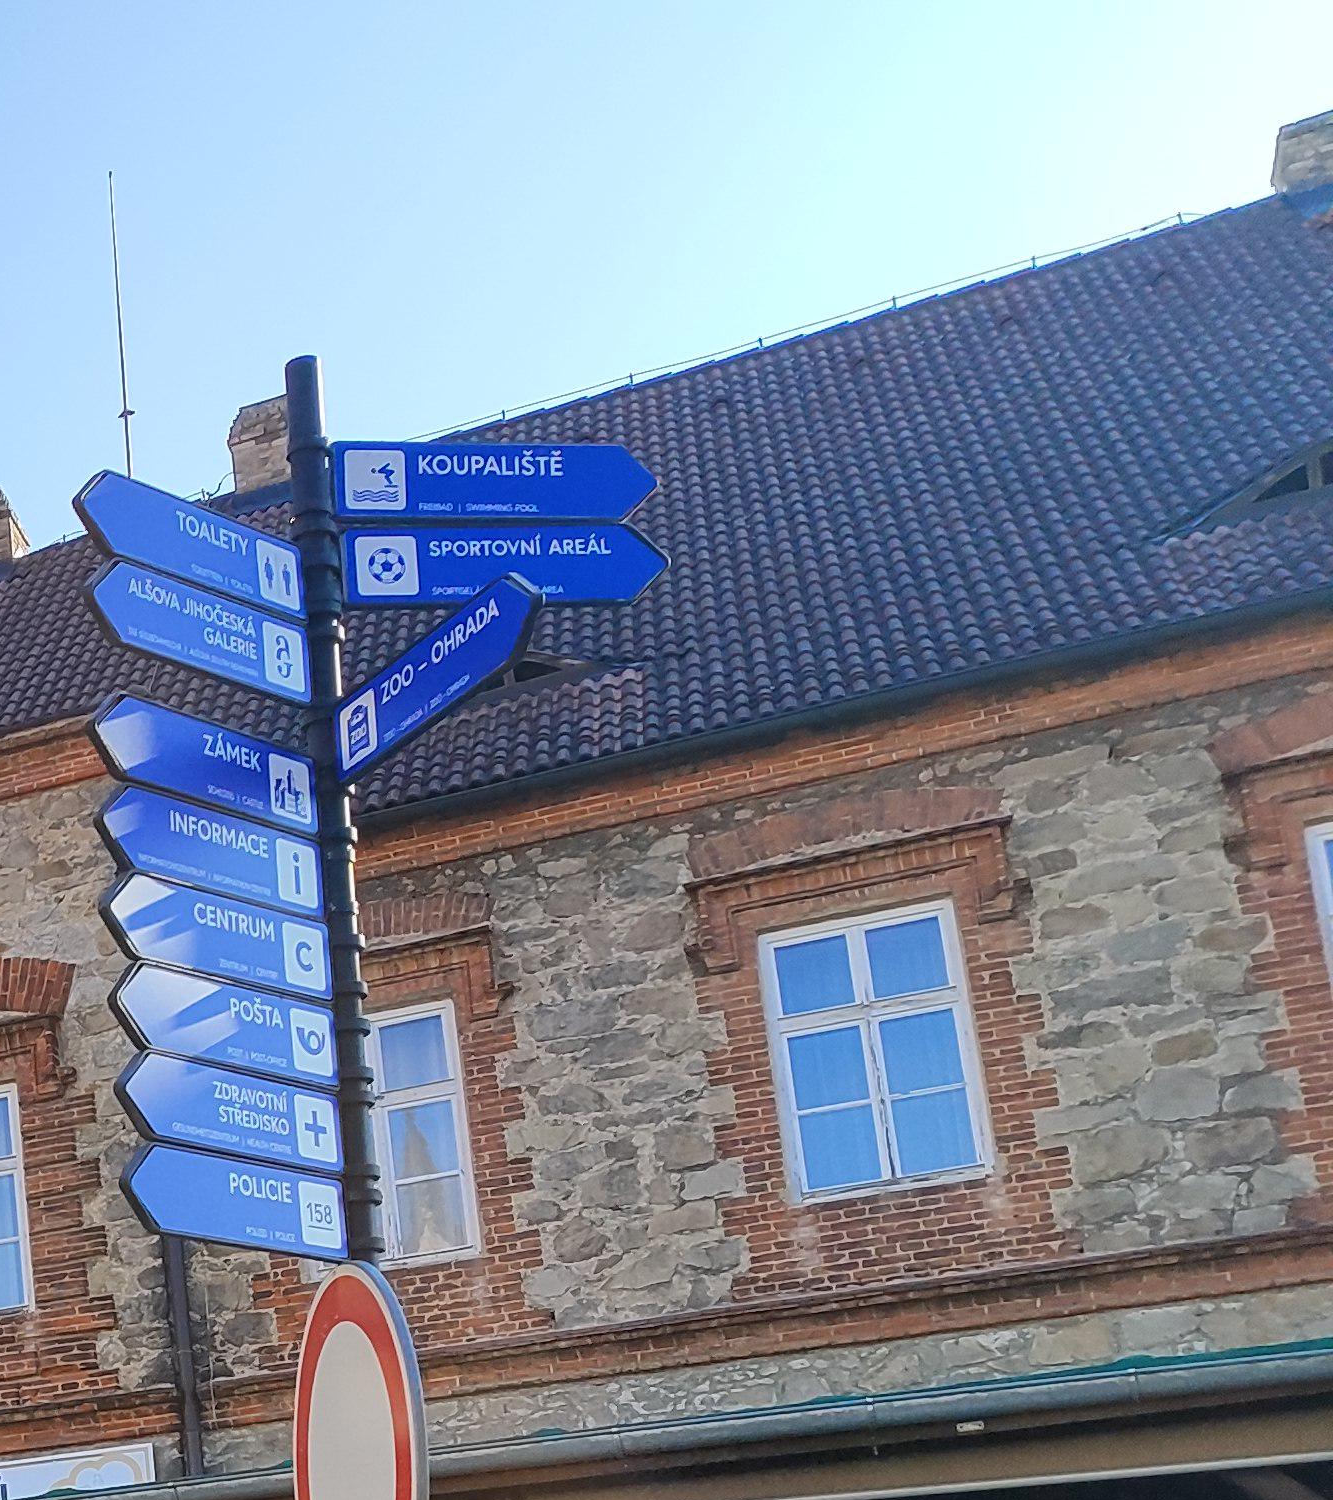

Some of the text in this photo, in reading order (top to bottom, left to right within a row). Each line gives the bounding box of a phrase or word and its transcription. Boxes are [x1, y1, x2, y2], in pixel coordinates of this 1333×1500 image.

[417, 449, 565, 477] KOUPALIŠTĚ
[175, 510, 249, 556] TOALETY
[428, 532, 613, 557] SPORTOVNÍ AREÁL
[128, 578, 181, 611] ALŠOVA
[182, 599, 257, 638] JIHOČESKÁ
[203, 627, 258, 660] GALERIE
[380, 664, 414, 705] ZOO
[431, 597, 501, 664] OHRADA
[202, 732, 262, 772] ZÁMEK
[169, 810, 270, 858] INFORMACE
[193, 902, 276, 942] CENTRUM
[229, 996, 284, 1029] POŠTA
[212, 1080, 288, 1113] ZDRAVOTNÍ
[218, 1103, 290, 1135] STŘEDISKO
[229, 1172, 293, 1204] POLICIE
[306, 1202, 333, 1224] 158
